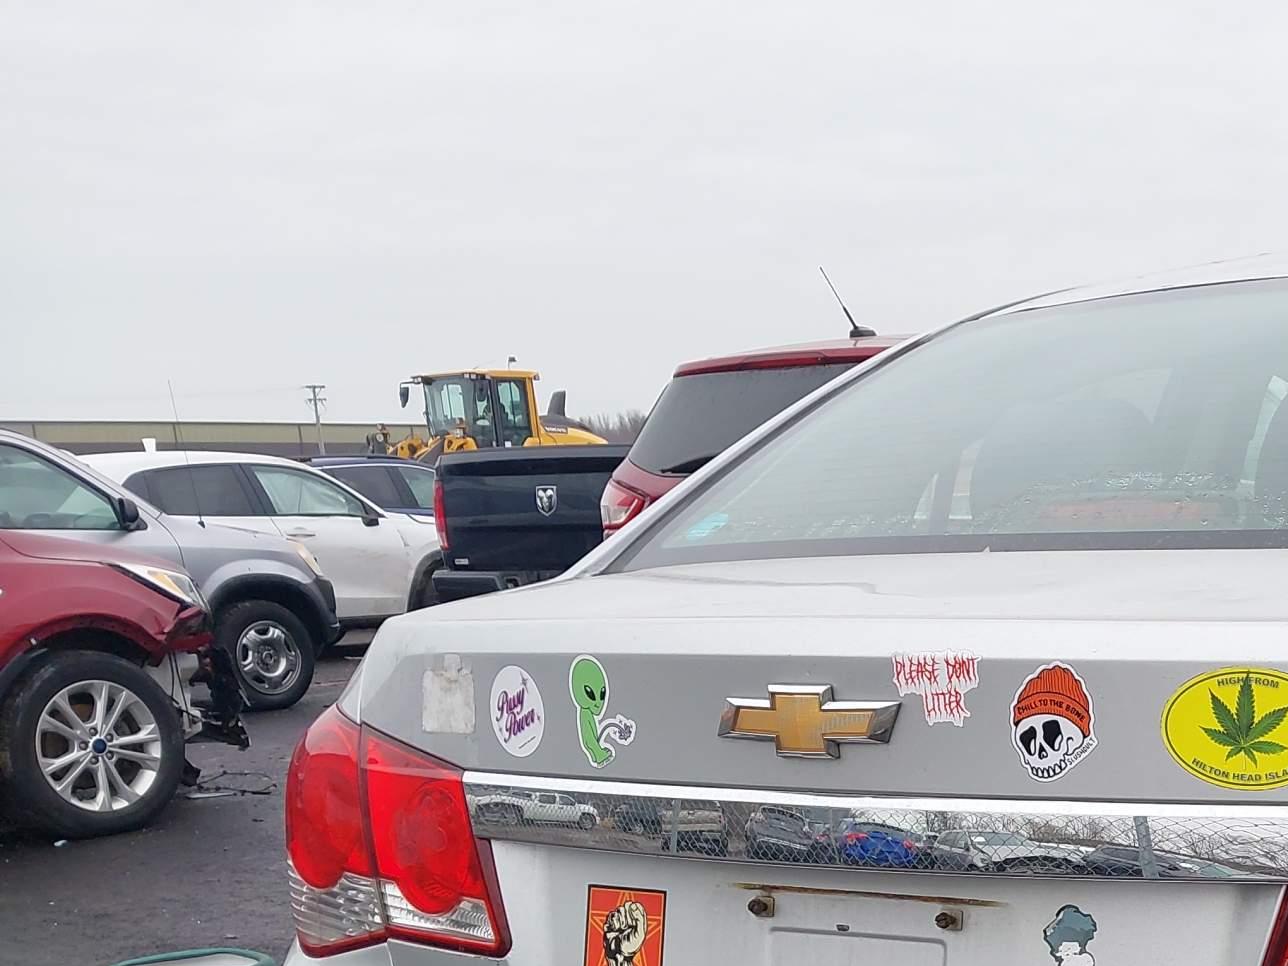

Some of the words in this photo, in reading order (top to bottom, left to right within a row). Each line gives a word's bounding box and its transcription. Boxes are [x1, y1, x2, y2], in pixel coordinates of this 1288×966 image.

[895, 655, 940, 687] PLEASE
[944, 655, 979, 682] DONT
[1217, 676, 1246, 687] HIGH
[1249, 677, 1280, 689] FROM
[925, 688, 969, 718] LITTER
[1017, 701, 1037, 715] CHILL
[1040, 699, 1048, 707] TO
[1049, 699, 1064, 708] THE
[1065, 704, 1085, 722] BONE
[504, 708, 534, 743] Power
[1191, 757, 1229, 779] HILTON
[1232, 771, 1262, 782] HEAD
